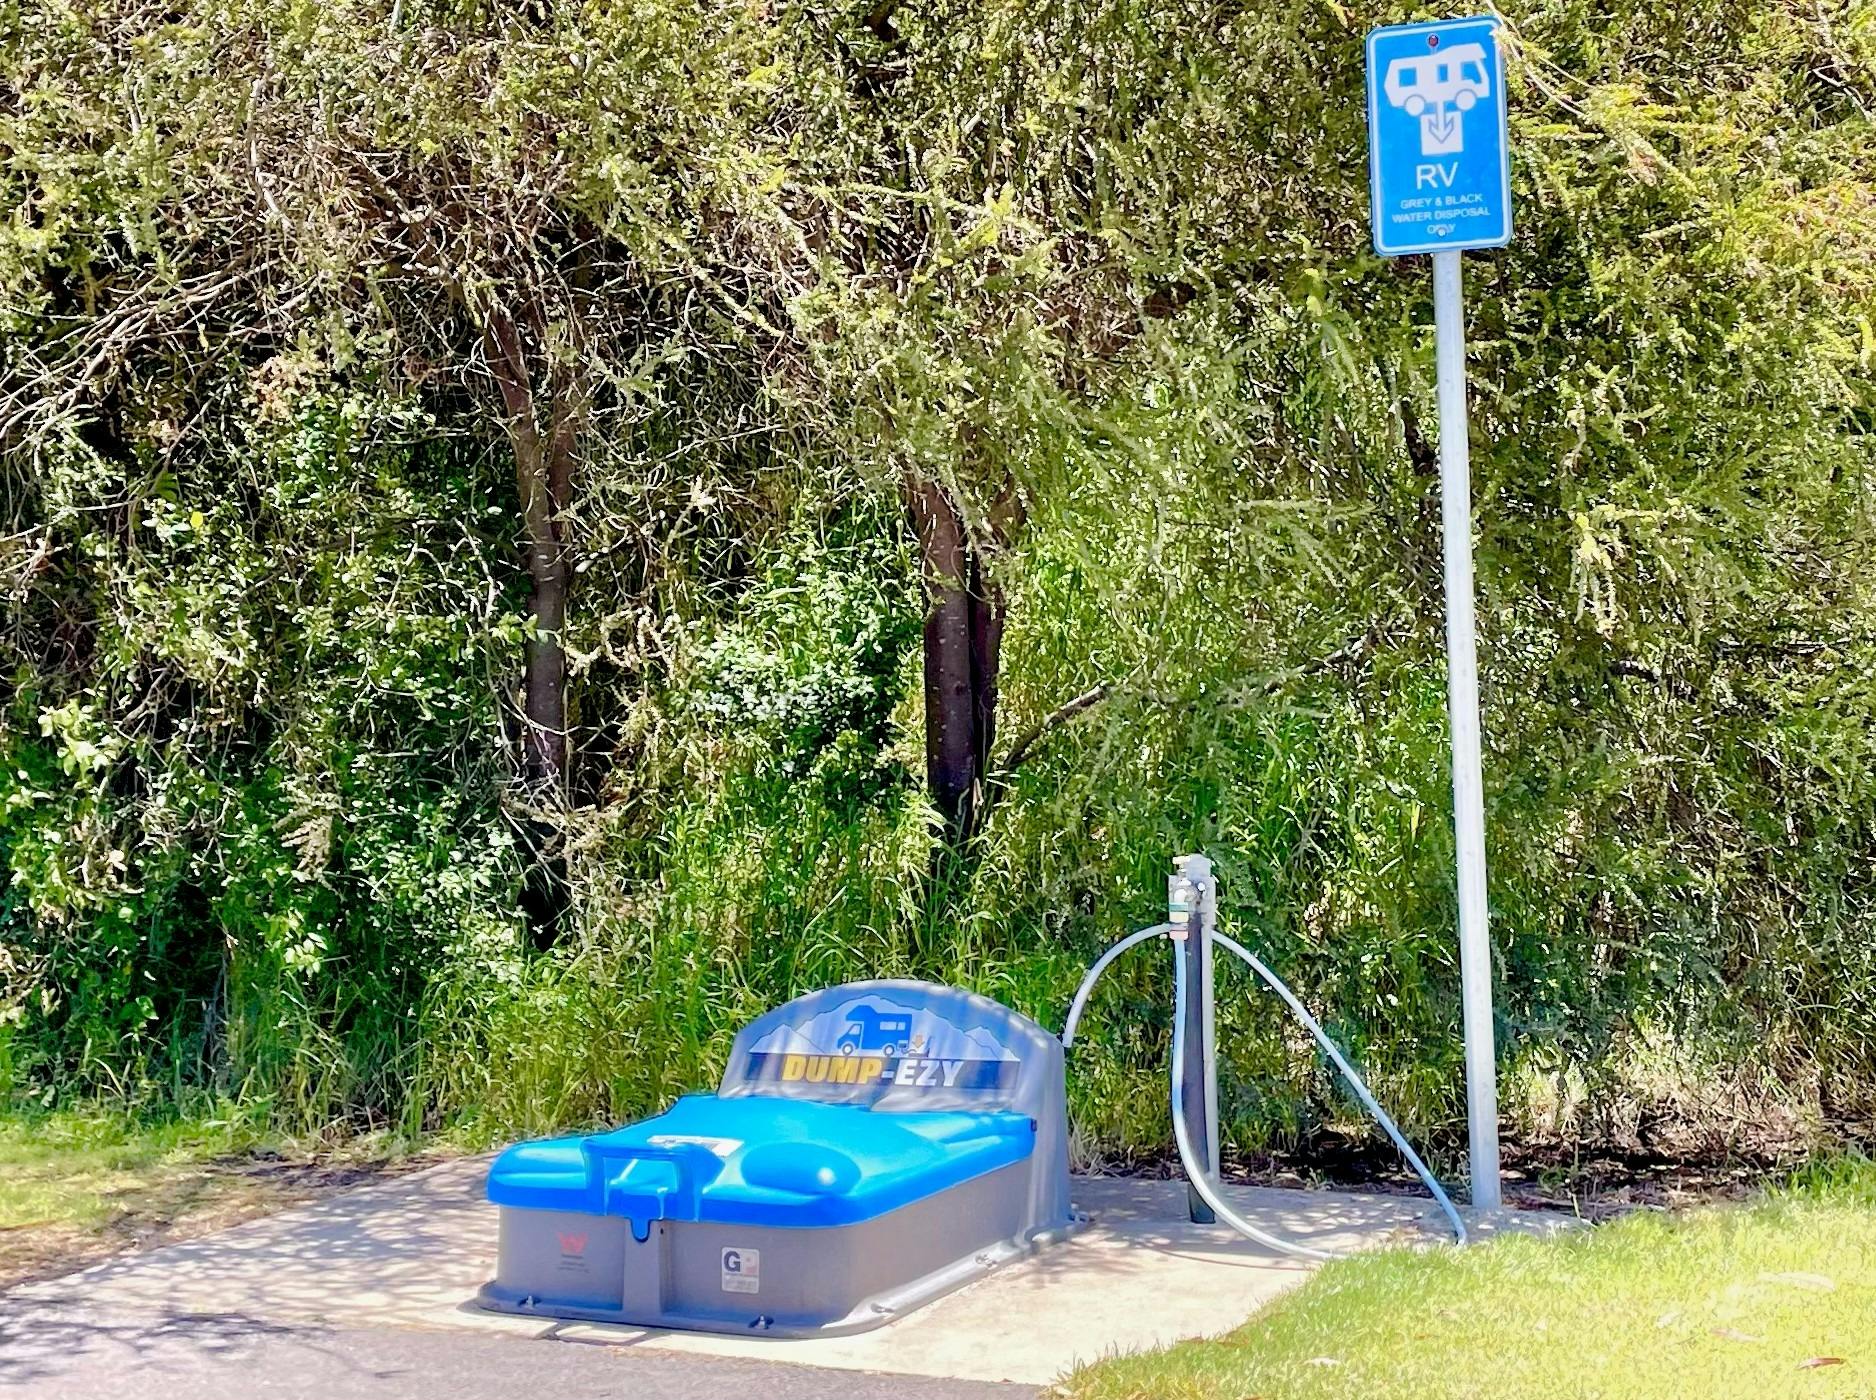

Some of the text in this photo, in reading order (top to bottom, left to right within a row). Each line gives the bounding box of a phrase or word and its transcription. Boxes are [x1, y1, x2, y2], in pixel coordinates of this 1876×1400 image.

[1416, 161, 1458, 190] RV
[1400, 193, 1483, 209] GREY & BLACK
[1392, 207, 1491, 223] WATER DISPOSAL
[781, 1055, 963, 1086] DUMP-EZY
[723, 1250, 741, 1273] G
